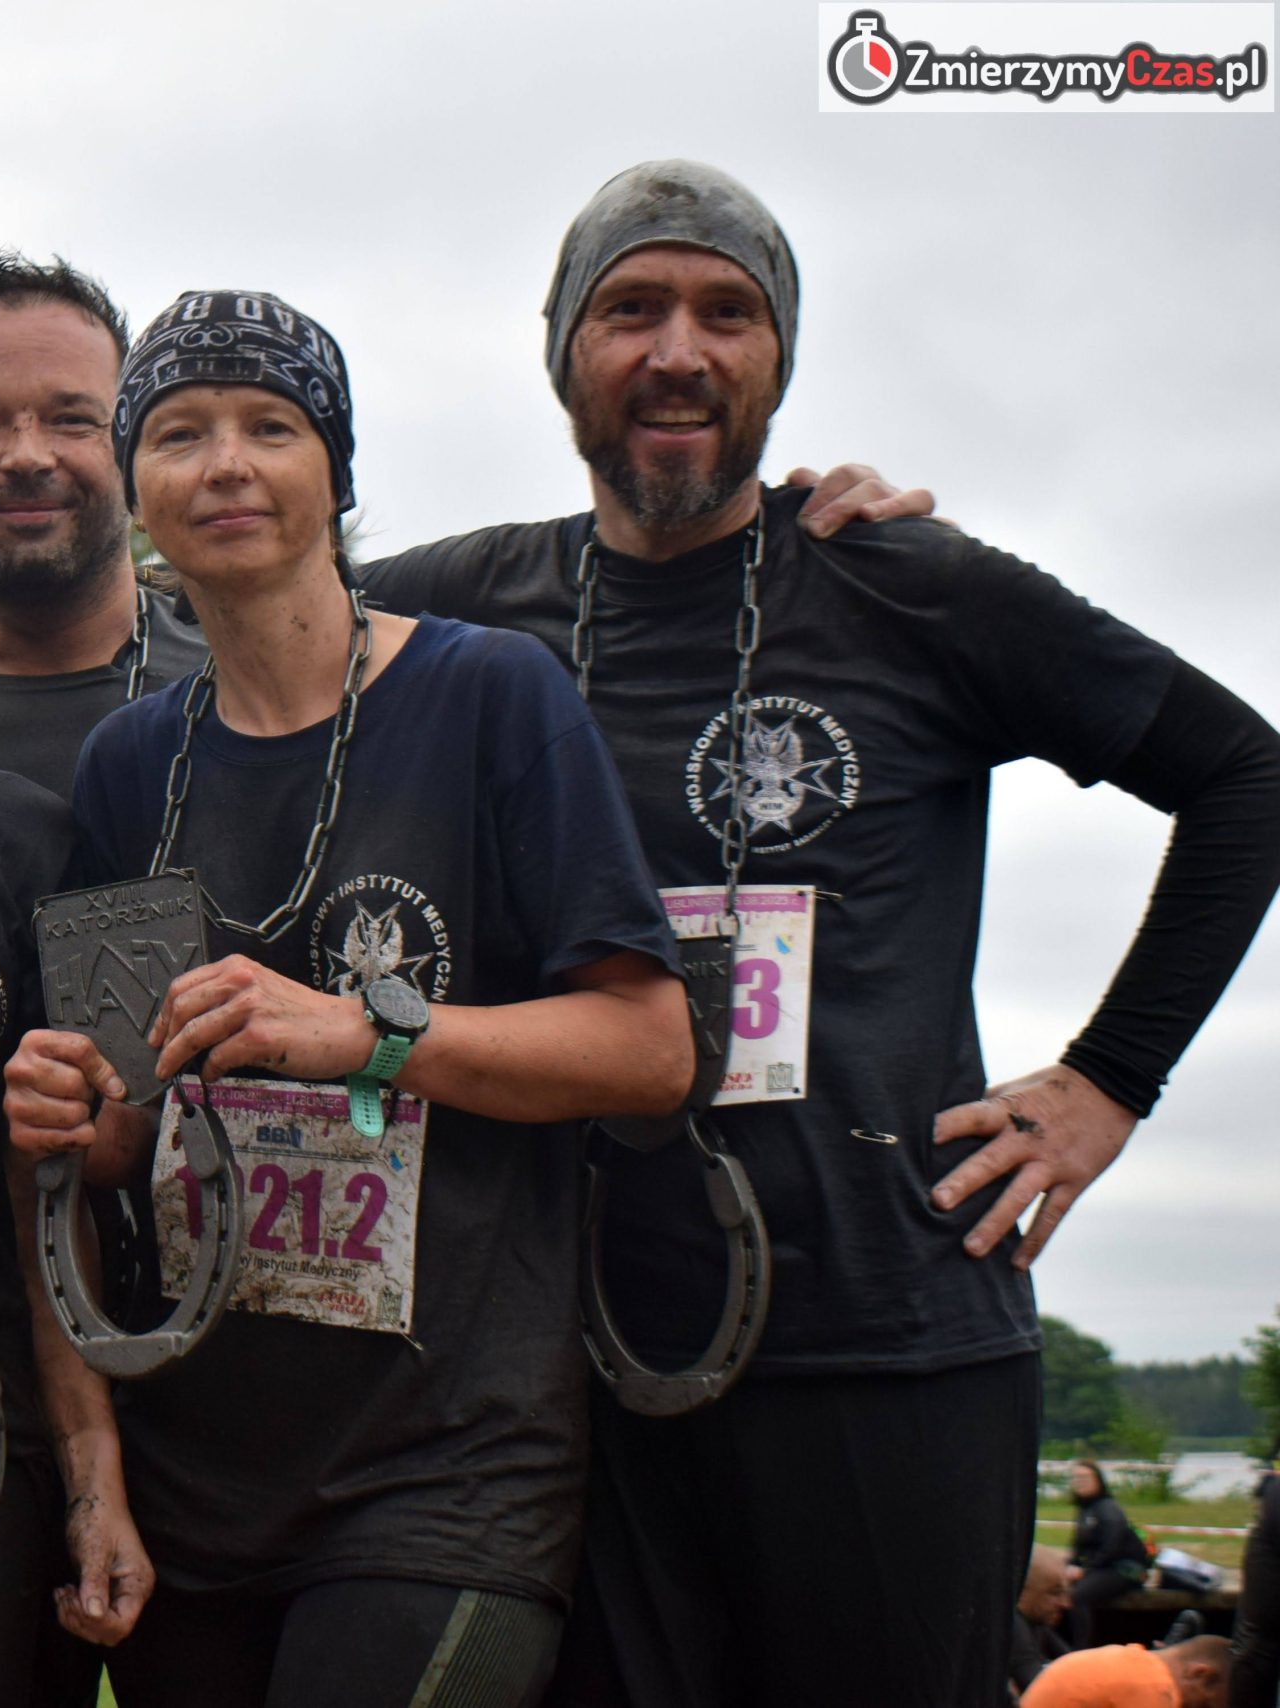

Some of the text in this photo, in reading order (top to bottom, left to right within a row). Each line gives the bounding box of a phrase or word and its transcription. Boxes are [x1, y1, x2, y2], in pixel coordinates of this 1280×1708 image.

[685, 696, 861, 814] WOJSKOWY STYTUT MEDYCZNY
[85, 884, 144, 912] XVIII
[309, 874, 451, 1002] OJSKOWY INSTYTUT MEDYCZN
[175, 1163, 388, 1263] 121.2
